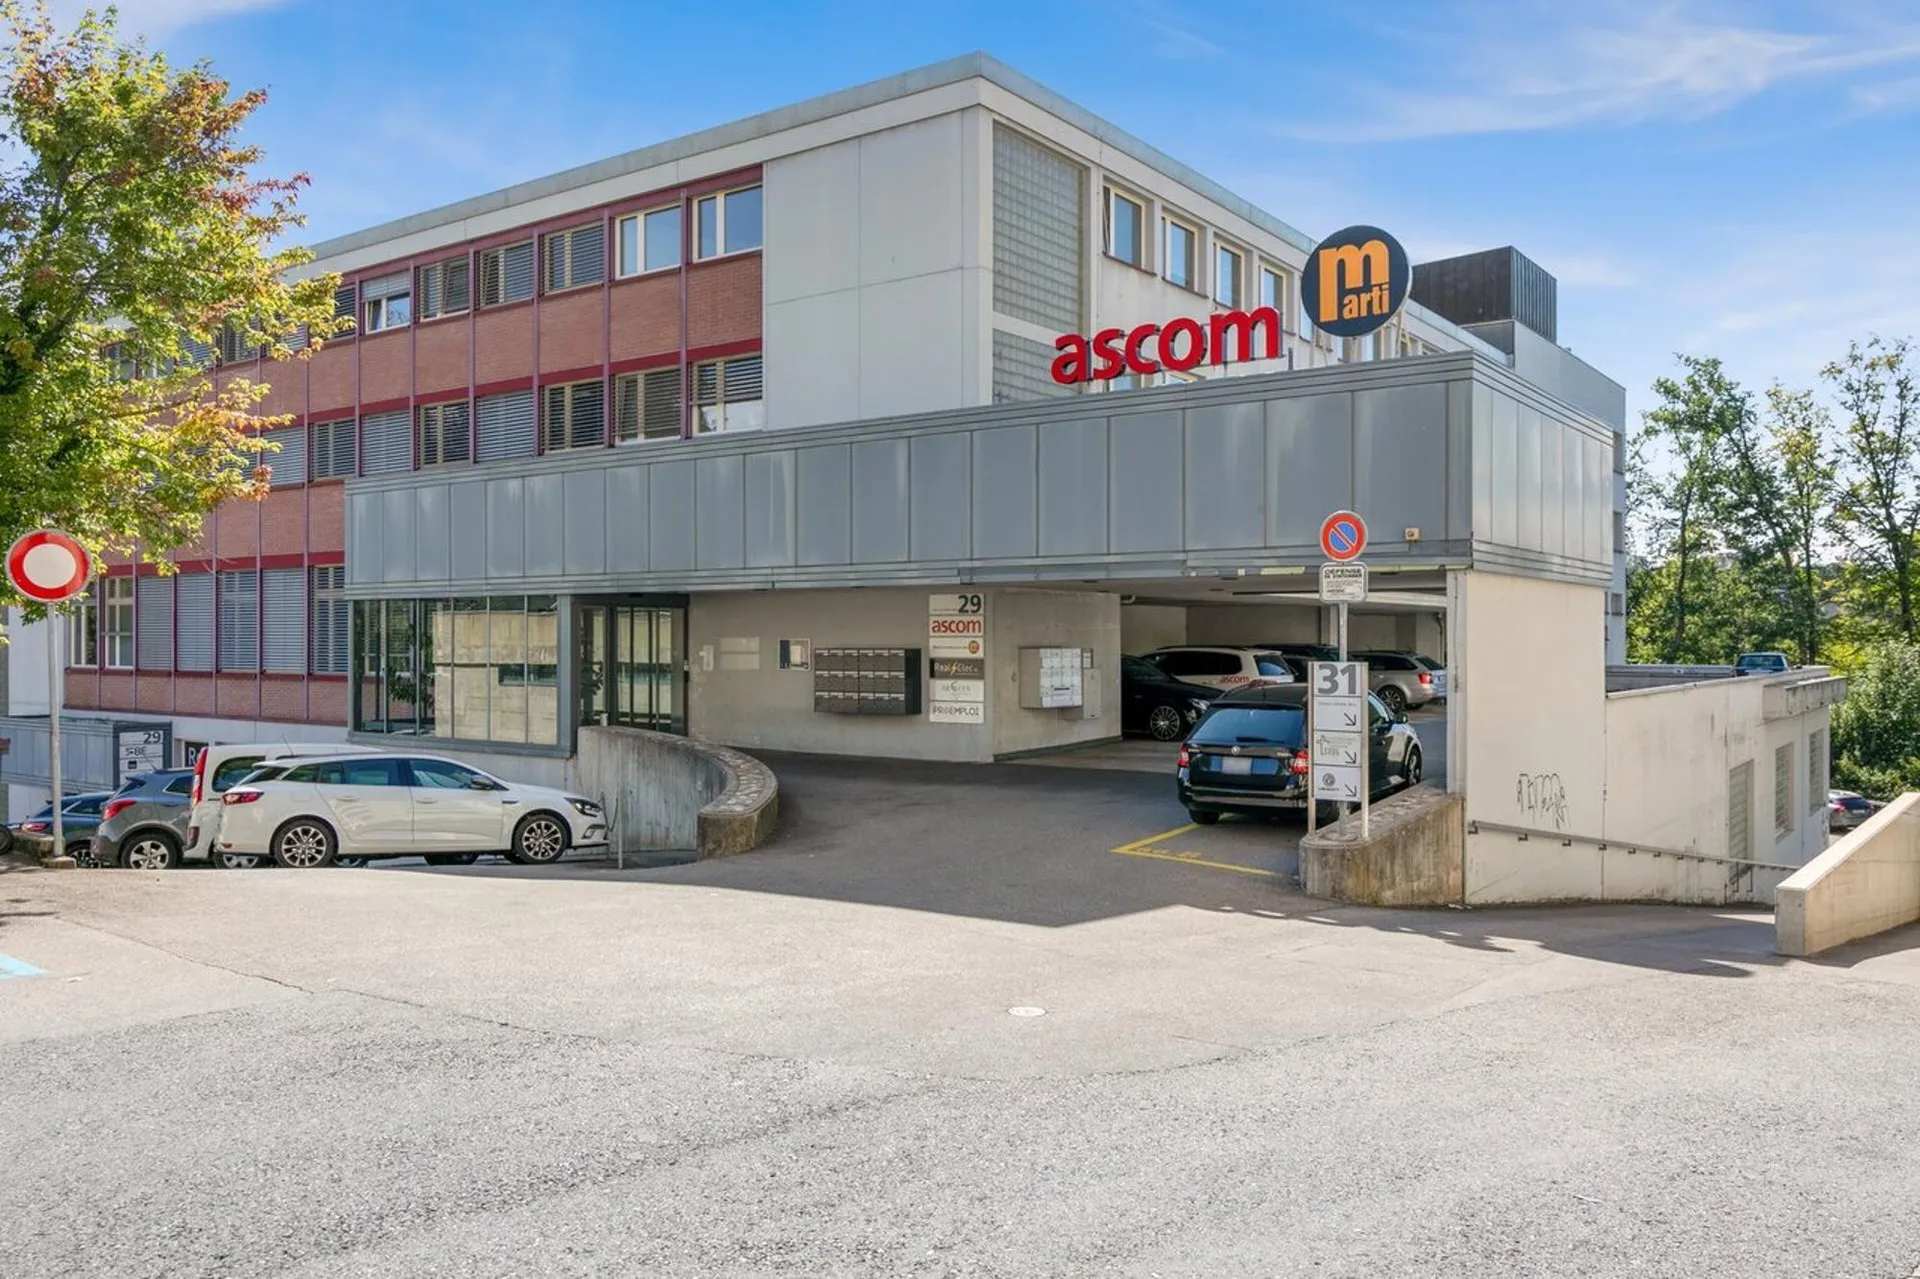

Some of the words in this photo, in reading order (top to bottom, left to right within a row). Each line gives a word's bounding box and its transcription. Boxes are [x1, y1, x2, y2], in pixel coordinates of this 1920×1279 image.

[1049, 306, 1281, 384] ascom
[958, 594, 982, 614] 29
[931, 619, 982, 634] ascom
[1317, 663, 1357, 695] 31
[143, 731, 161, 744] 29
